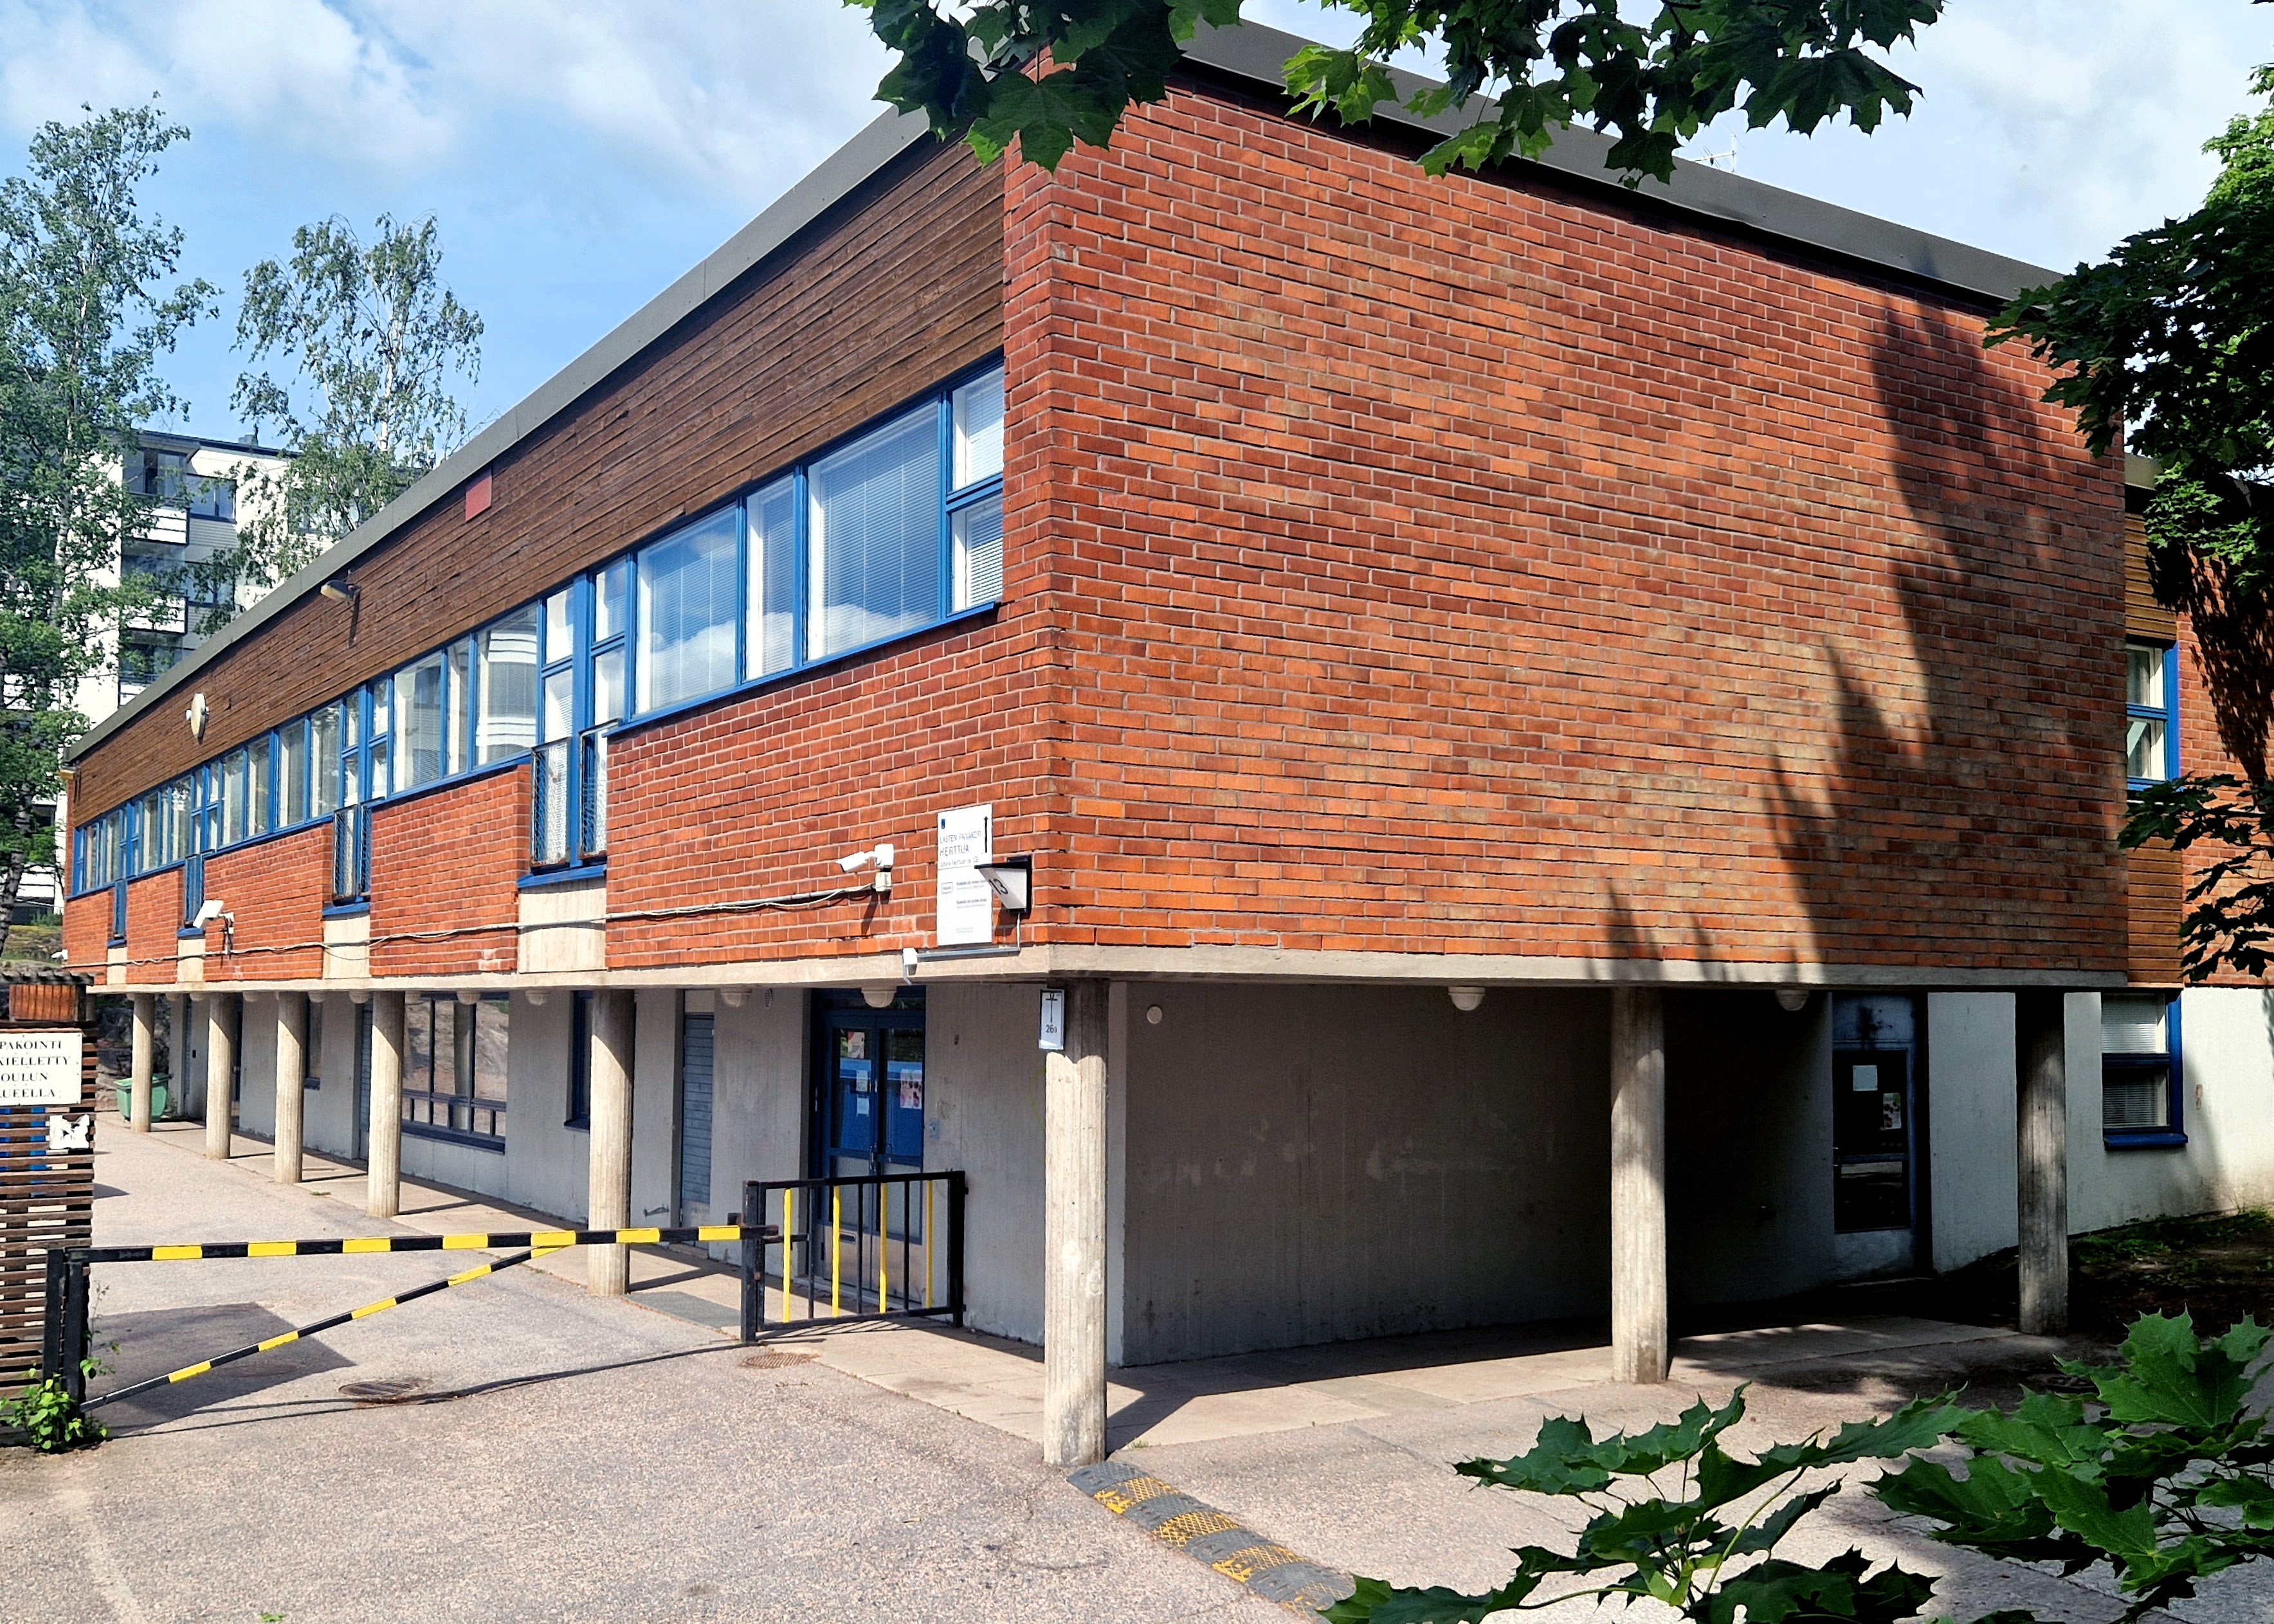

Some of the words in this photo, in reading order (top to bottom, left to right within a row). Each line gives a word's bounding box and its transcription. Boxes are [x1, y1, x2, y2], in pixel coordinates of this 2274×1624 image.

[940, 844, 969, 856] HERTTUA
[988, 878, 1008, 895] 13
[0, 1088, 55, 1098] UEELLA
